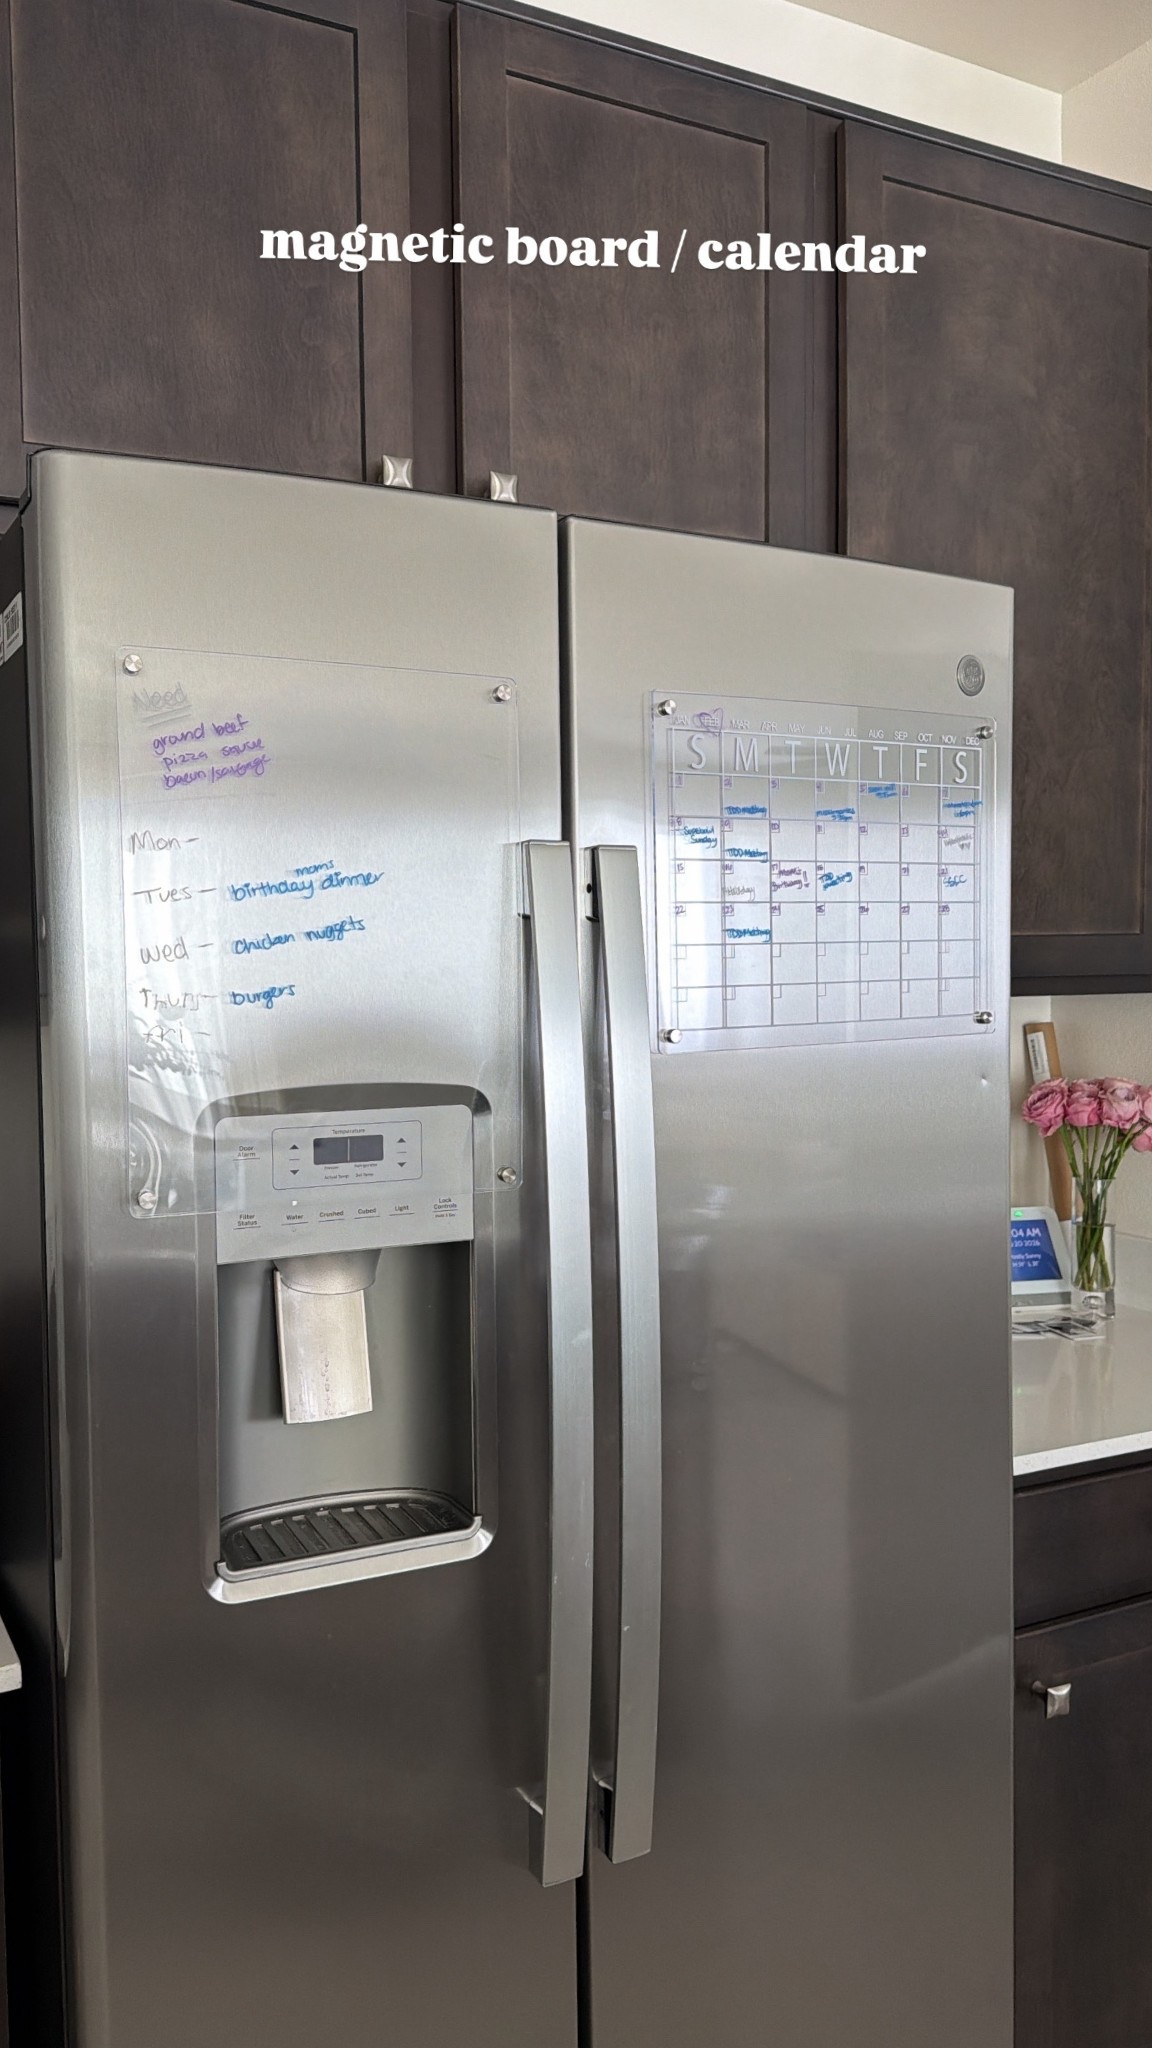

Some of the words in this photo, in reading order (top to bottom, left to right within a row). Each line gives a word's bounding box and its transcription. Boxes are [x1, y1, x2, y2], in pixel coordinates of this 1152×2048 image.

[153, 722, 205, 756] ground
[212, 713, 249, 736] beef
[731, 719, 749, 730] MAR
[761, 721, 778, 732] APR
[788, 723, 806, 734] MAY
[817, 725, 832, 736] JUN
[844, 727, 857, 738] JUL
[868, 729, 884, 739] AUG
[894, 731, 908, 741] SEP
[918, 733, 933, 743] OCT
[942, 735, 957, 745] NOV
[966, 736, 980, 746] DEC
[163, 751, 208, 772] pizza
[690, 733, 707, 770] S
[735, 737, 759, 772] M
[785, 740, 801, 774] T
[825, 742, 850, 777] W
[873, 746, 888, 779] T
[916, 748, 928, 781] F
[954, 750, 968, 784] S
[230, 880, 315, 901] birthday
[305, 915, 366, 942] nuggets
[230, 984, 296, 1010] burgers
[319, 1209, 344, 1218] Crushed
[358, 1207, 377, 1215] Cubed
[1026, 1227, 1042, 1238] AM
